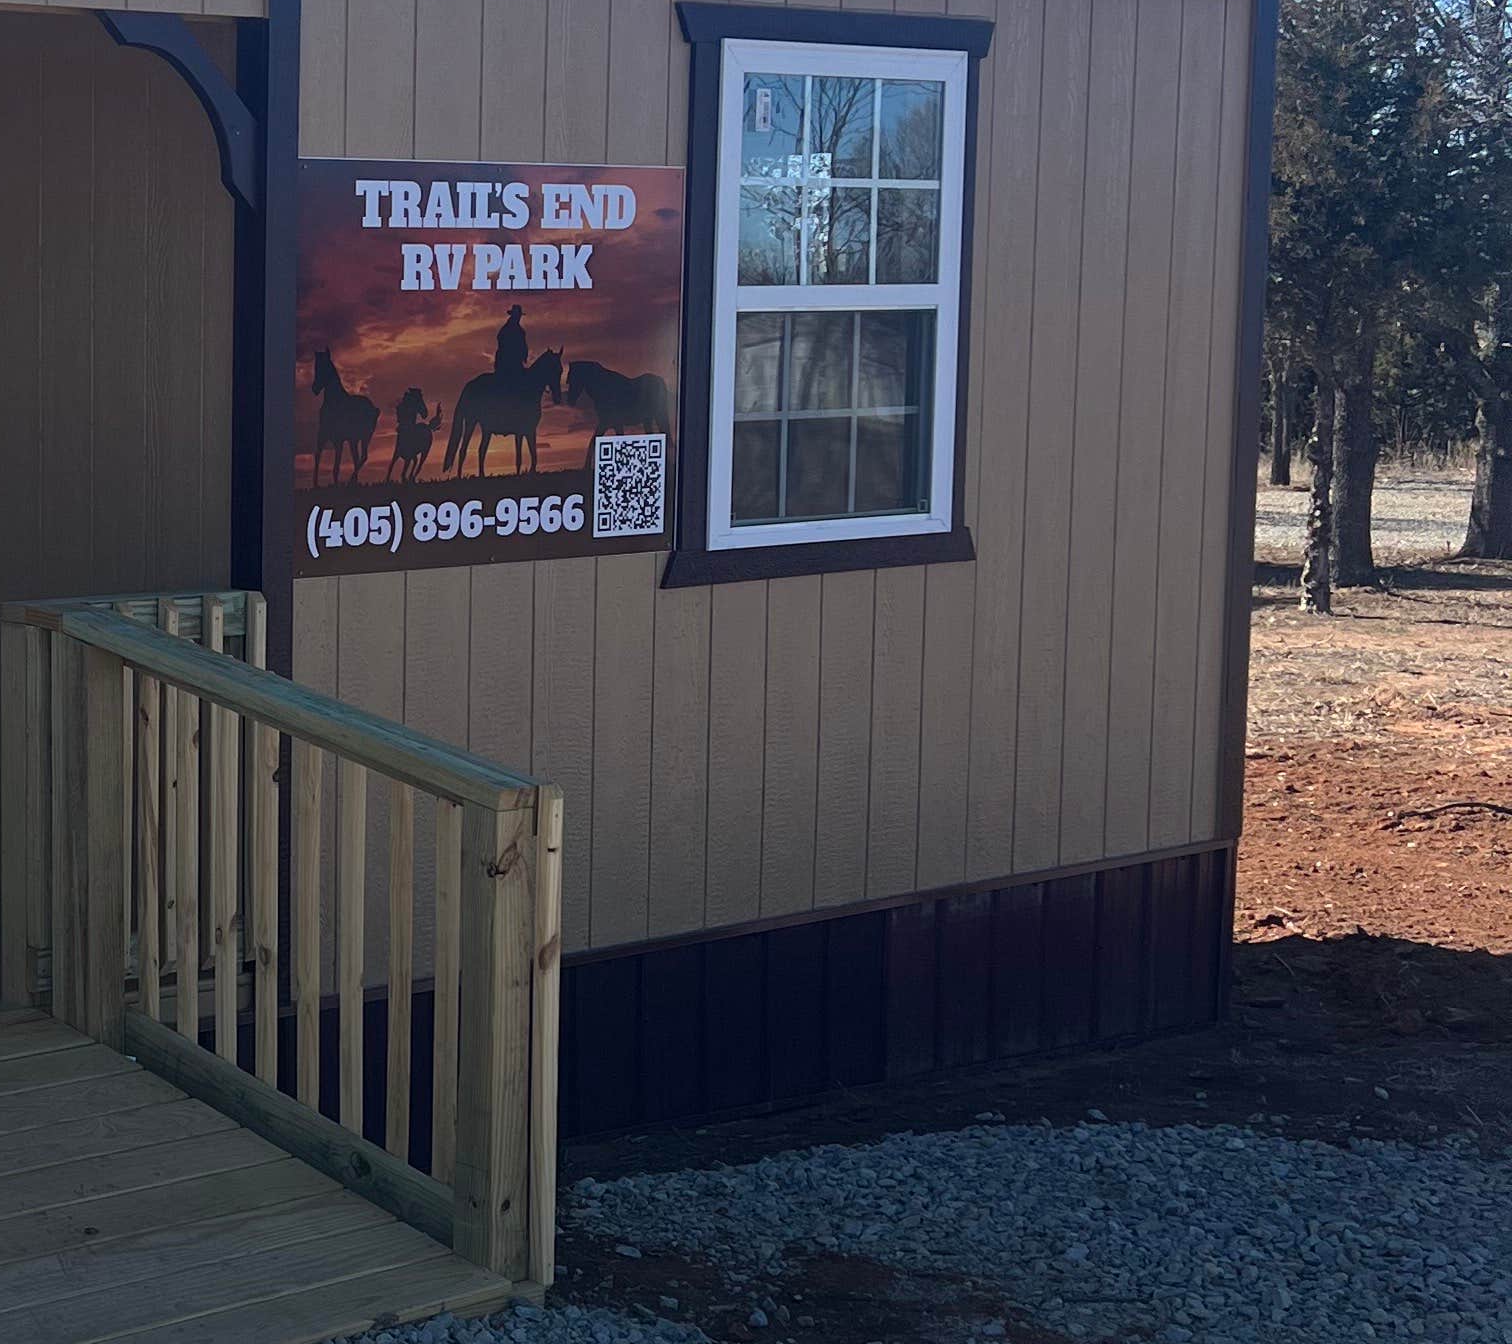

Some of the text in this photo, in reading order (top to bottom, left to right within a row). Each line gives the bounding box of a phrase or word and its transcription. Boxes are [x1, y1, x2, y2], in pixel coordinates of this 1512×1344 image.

[356, 180, 637, 229] TRAIL'S END
[400, 244, 593, 290] RV PARK
[306, 494, 584, 558] (405) 896-9566
